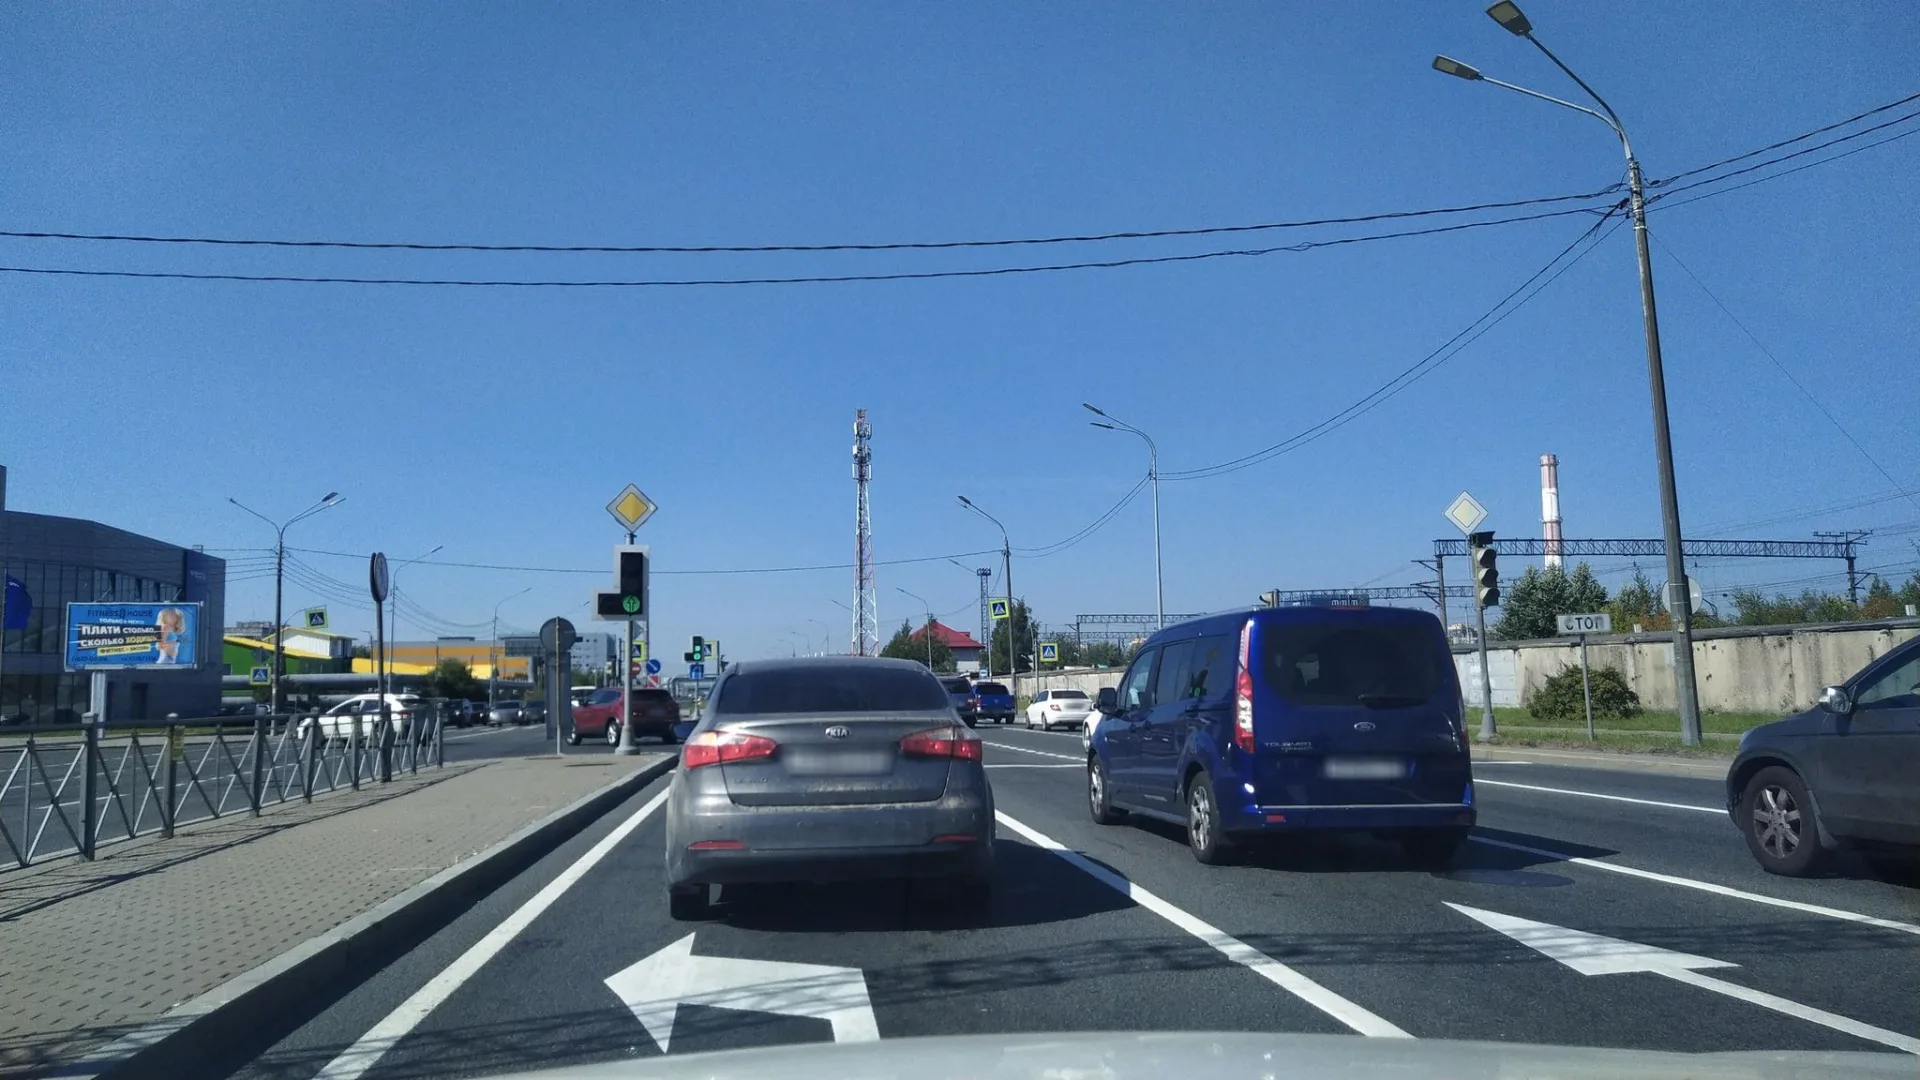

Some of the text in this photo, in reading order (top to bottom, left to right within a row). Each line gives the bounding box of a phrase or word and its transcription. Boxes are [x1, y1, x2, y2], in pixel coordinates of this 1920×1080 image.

[87, 609, 153, 618] FITNESS HOUSE
[81, 625, 121, 636] ПЛАТИ
[80, 637, 124, 647] СКОЛЬКО
[830, 728, 847, 736] KIA
